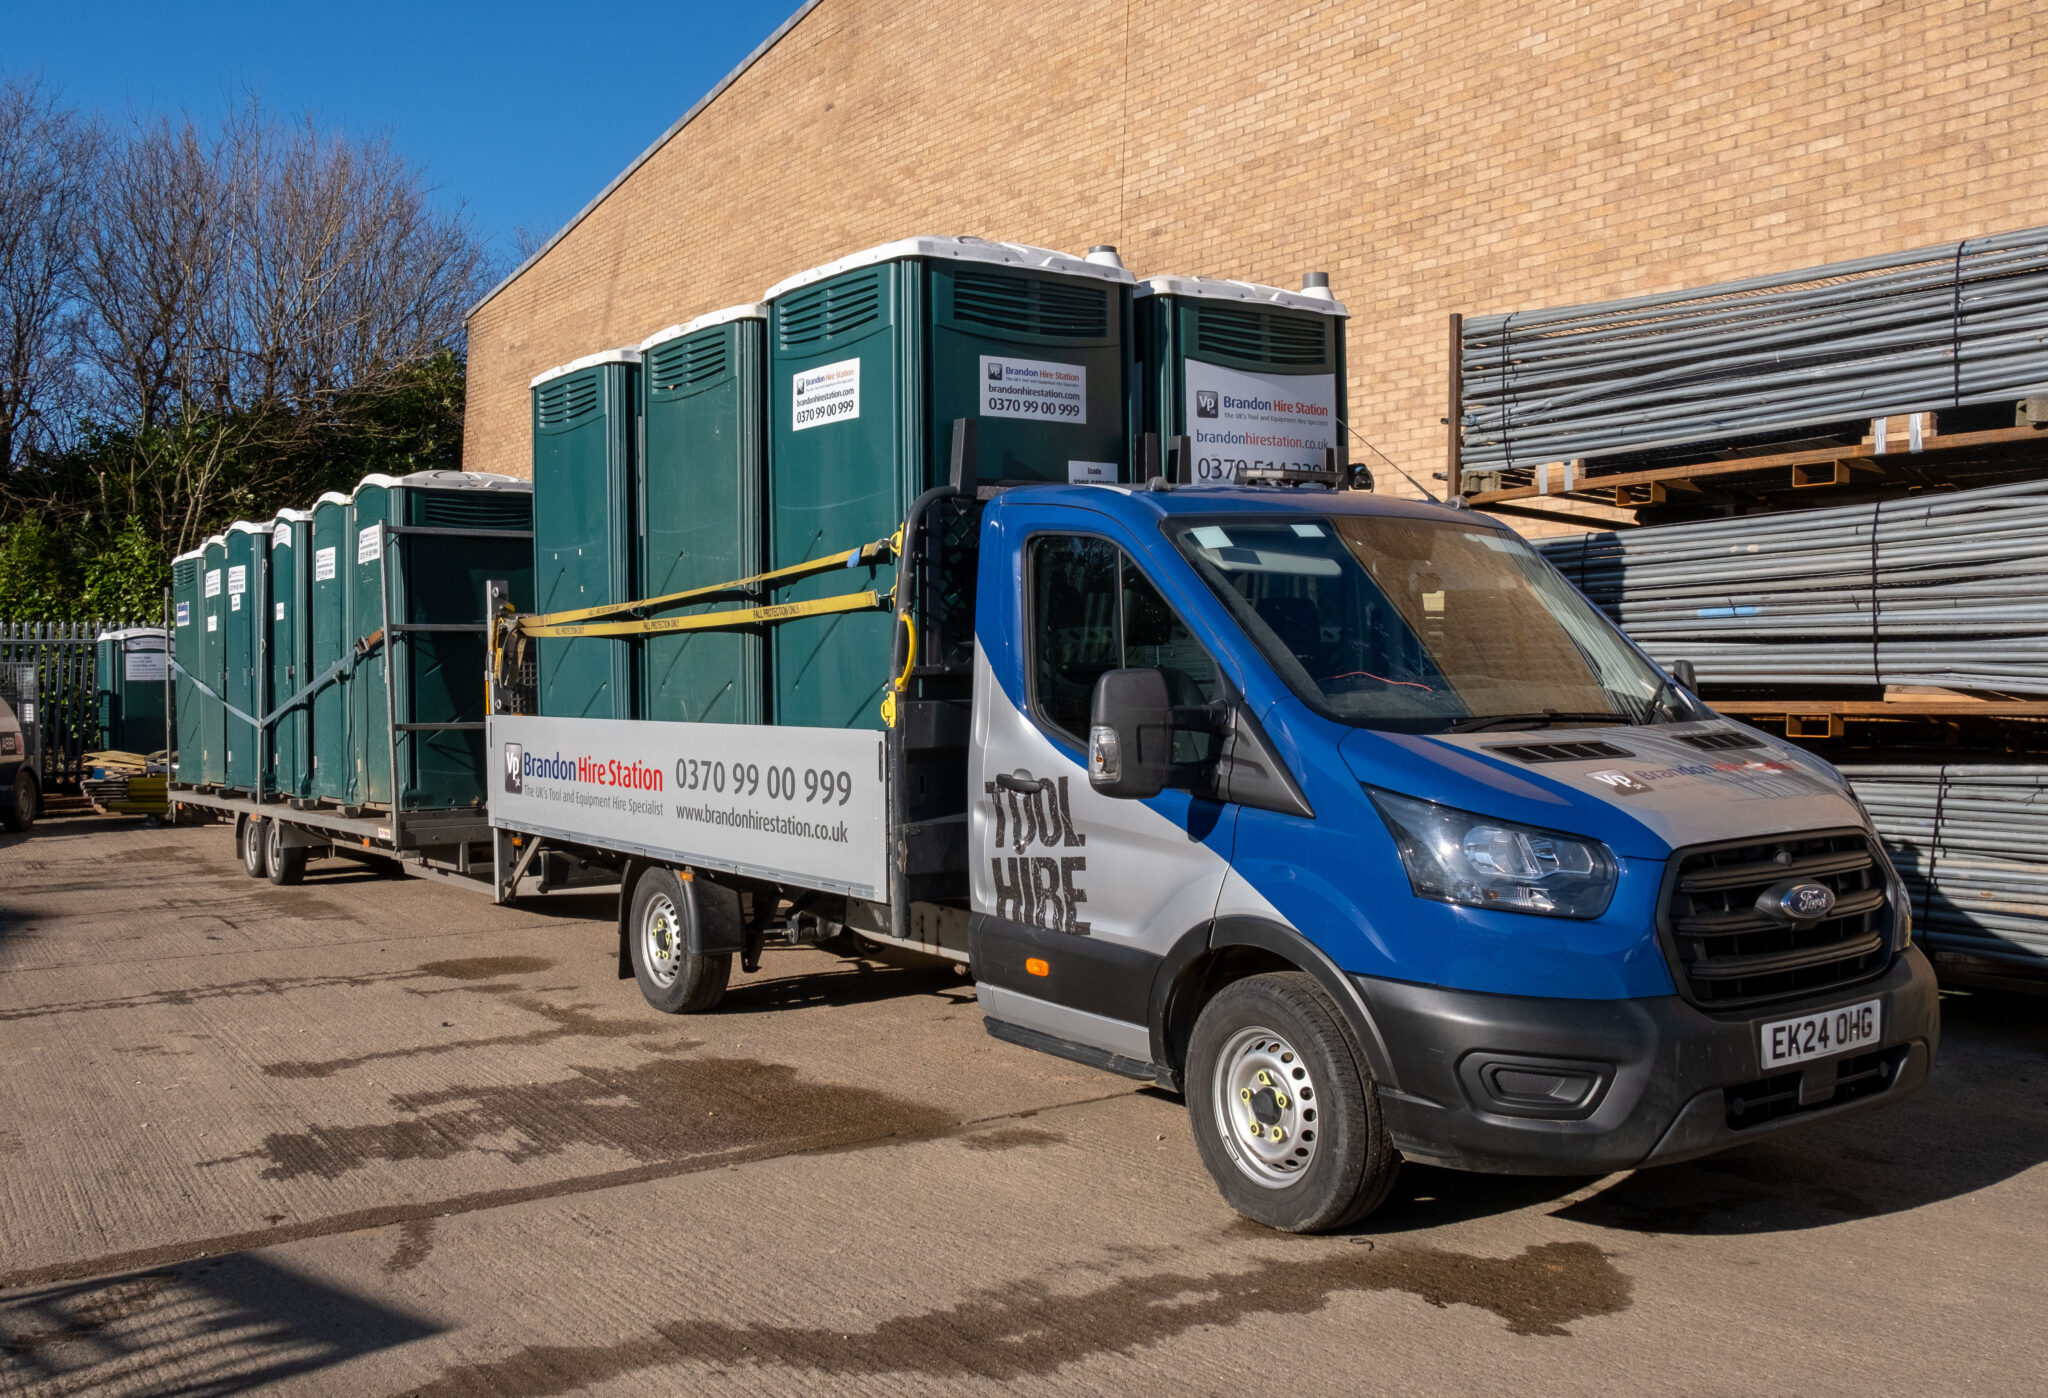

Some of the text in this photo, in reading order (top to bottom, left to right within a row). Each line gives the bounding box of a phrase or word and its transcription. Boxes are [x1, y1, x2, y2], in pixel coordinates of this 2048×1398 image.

[806, 375, 825, 386] Brandon
[826, 373, 835, 381] Hire
[836, 369, 854, 378] Station
[1005, 366, 1038, 377] Brandon
[1039, 370, 1054, 378] Hire
[1055, 371, 1079, 382] Station
[796, 387, 855, 407] brandonhirestation.com
[989, 383, 1080, 401] brandonhirestation.com
[796, 400, 854, 424] 0370 99 00 999
[989, 397, 1080, 417] 0370 99 00 999
[1199, 395, 1215, 411] Vp
[1223, 395, 1328, 417] Brandon Hire Station
[1196, 429, 1329, 450] brandonhirestation.co.uk
[763, 606, 788, 618] PROTECTION
[506, 751, 520, 781] Vp
[524, 751, 663, 792] Brandon Hire Station
[1633, 764, 1718, 780] Brandon
[676, 757, 852, 807] 0370 99 00 999
[1593, 774, 1633, 788] Vp
[524, 784, 663, 816] The UK's Tool and Equipment Hire Specialist
[676, 803, 849, 844] www.brandonhirestation.co.uk
[991, 856, 1091, 936] HIRE
[1799, 889, 1828, 911] Ford
[1772, 1006, 1872, 1060] EK24 OHG
